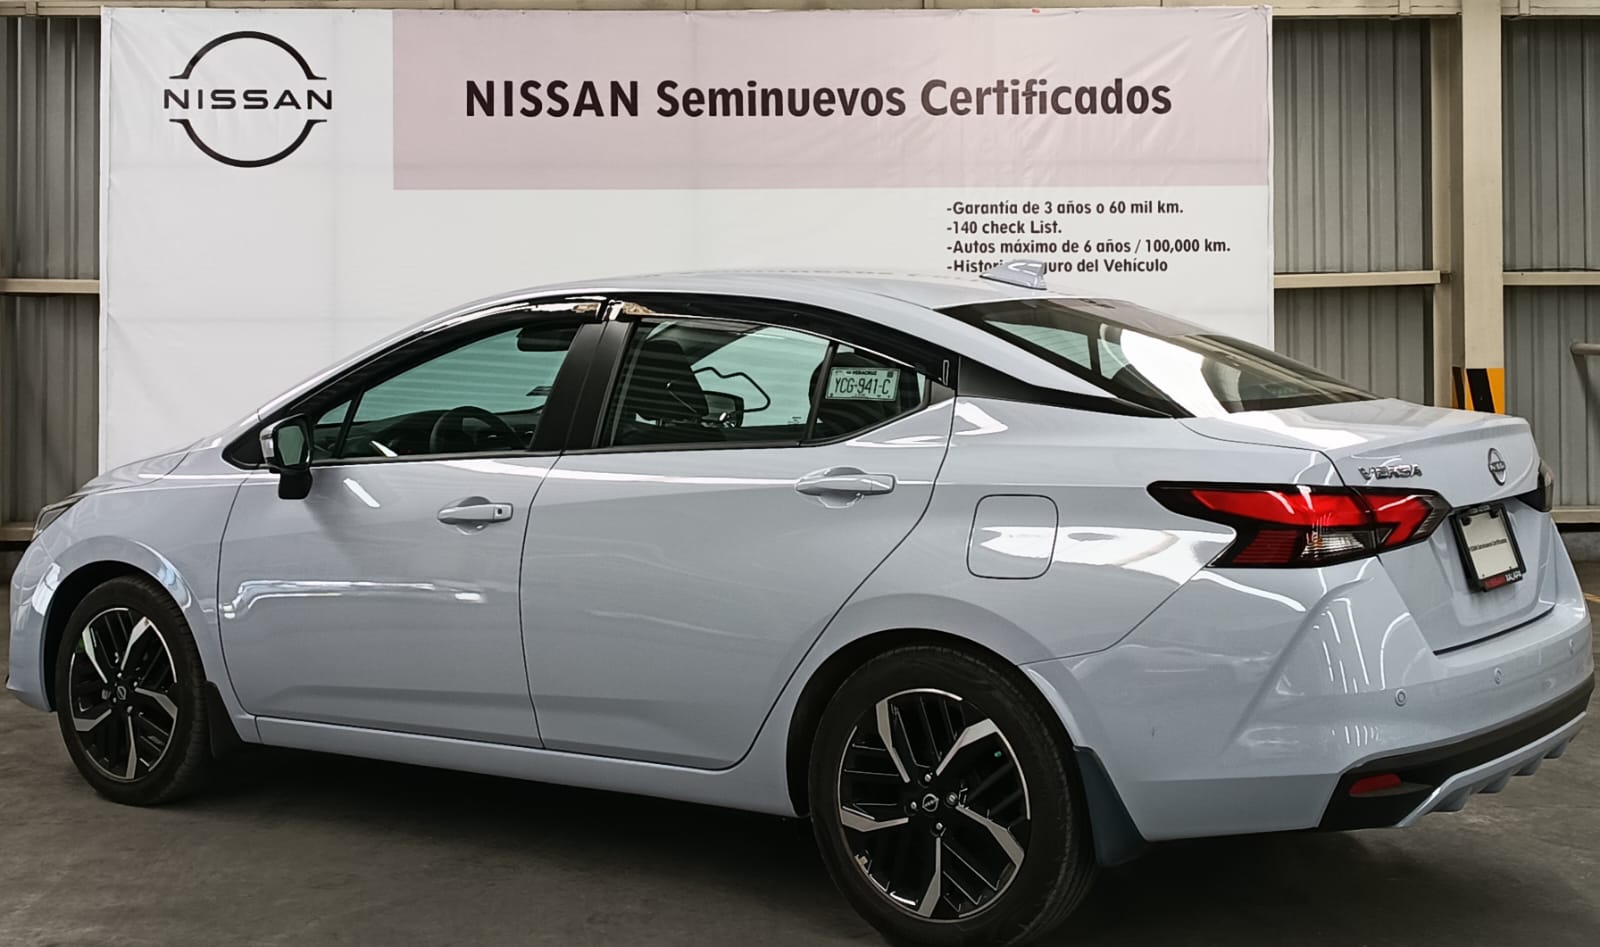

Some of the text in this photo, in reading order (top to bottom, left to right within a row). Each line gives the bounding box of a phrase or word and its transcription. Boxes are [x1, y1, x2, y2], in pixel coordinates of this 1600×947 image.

[163, 88, 333, 111] NISSAN
[466, 77, 1172, 118] NISSAN Seminuevos Certificados
[946, 200, 1184, 215] -Garantía de 3 años o 60 mil km.
[946, 219, 1062, 235] -140 check List.
[946, 238, 1231, 255] -Autos máximo de 6 años / 100,000 km.
[1076, 258, 1099, 273] del
[1103, 257, 1168, 273] Vehículo
[835, 377, 891, 395] YCG-941-C
